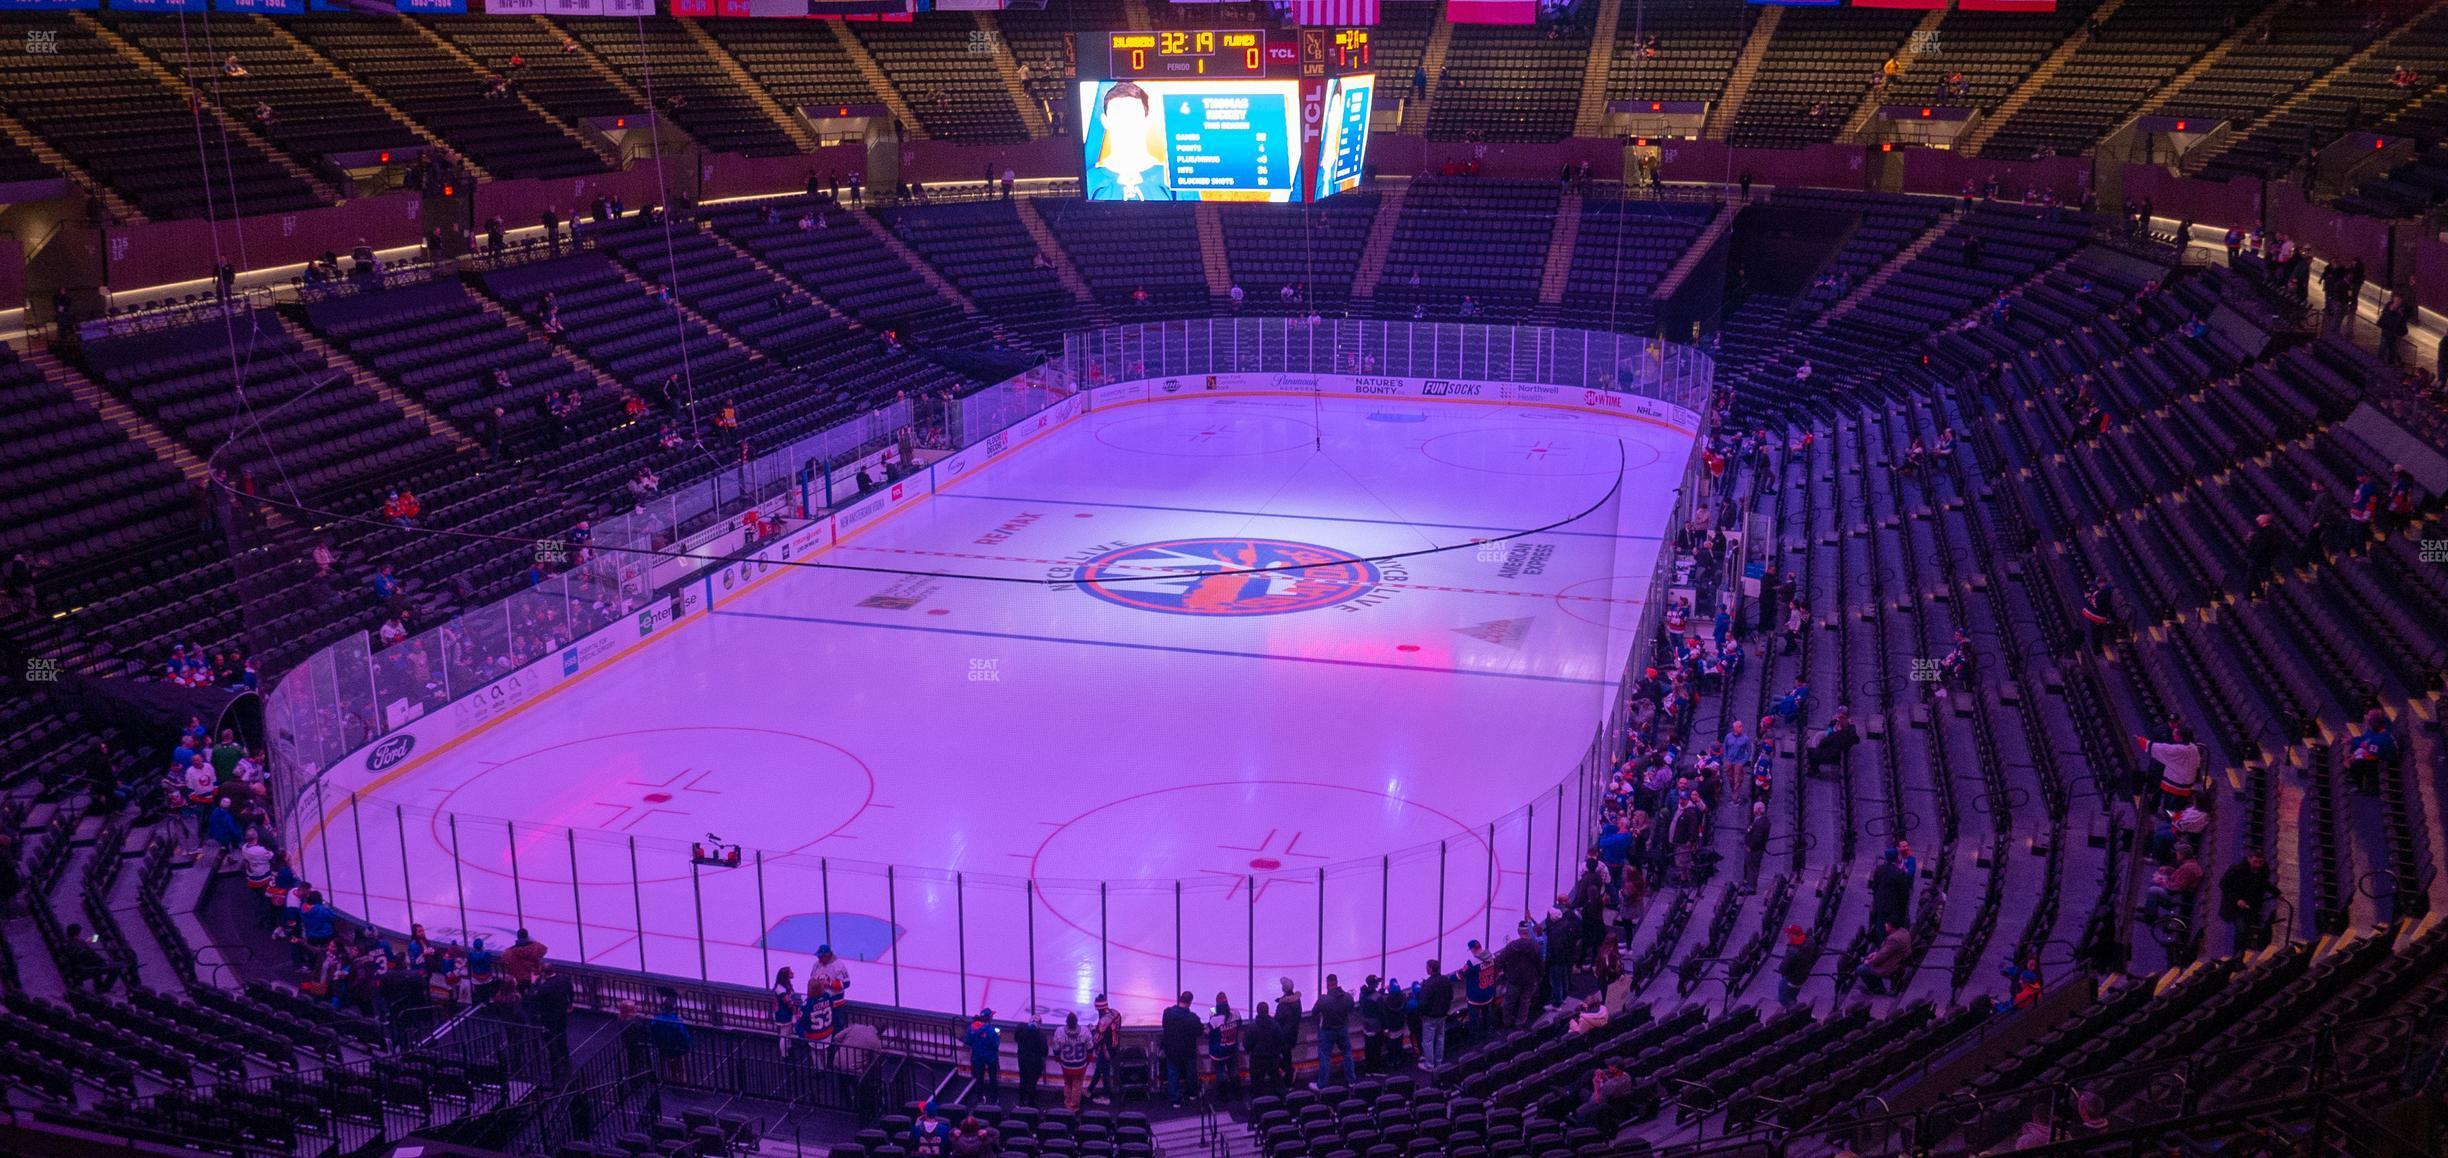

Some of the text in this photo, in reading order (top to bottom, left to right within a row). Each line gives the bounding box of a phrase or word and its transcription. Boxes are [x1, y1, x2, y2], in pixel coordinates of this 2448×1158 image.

[1132, 50, 1145, 70] 0
[1246, 48, 1259, 69] 0
[1270, 49, 1295, 58] TCL
[1167, 63, 1190, 71] PERIOD
[1304, 64, 1325, 74] LIVE
[1304, 85, 1321, 143] TCL
[1355, 377, 1404, 387] NATURE'S
[1355, 385, 1397, 394] BOUNTY
[1517, 384, 1559, 394] Northwell
[1584, 390, 1622, 408] SHOWTIME
[974, 512, 1044, 545] RE/MAX
[374, 738, 408, 769] Ford
[810, 1006, 833, 1030] 53
